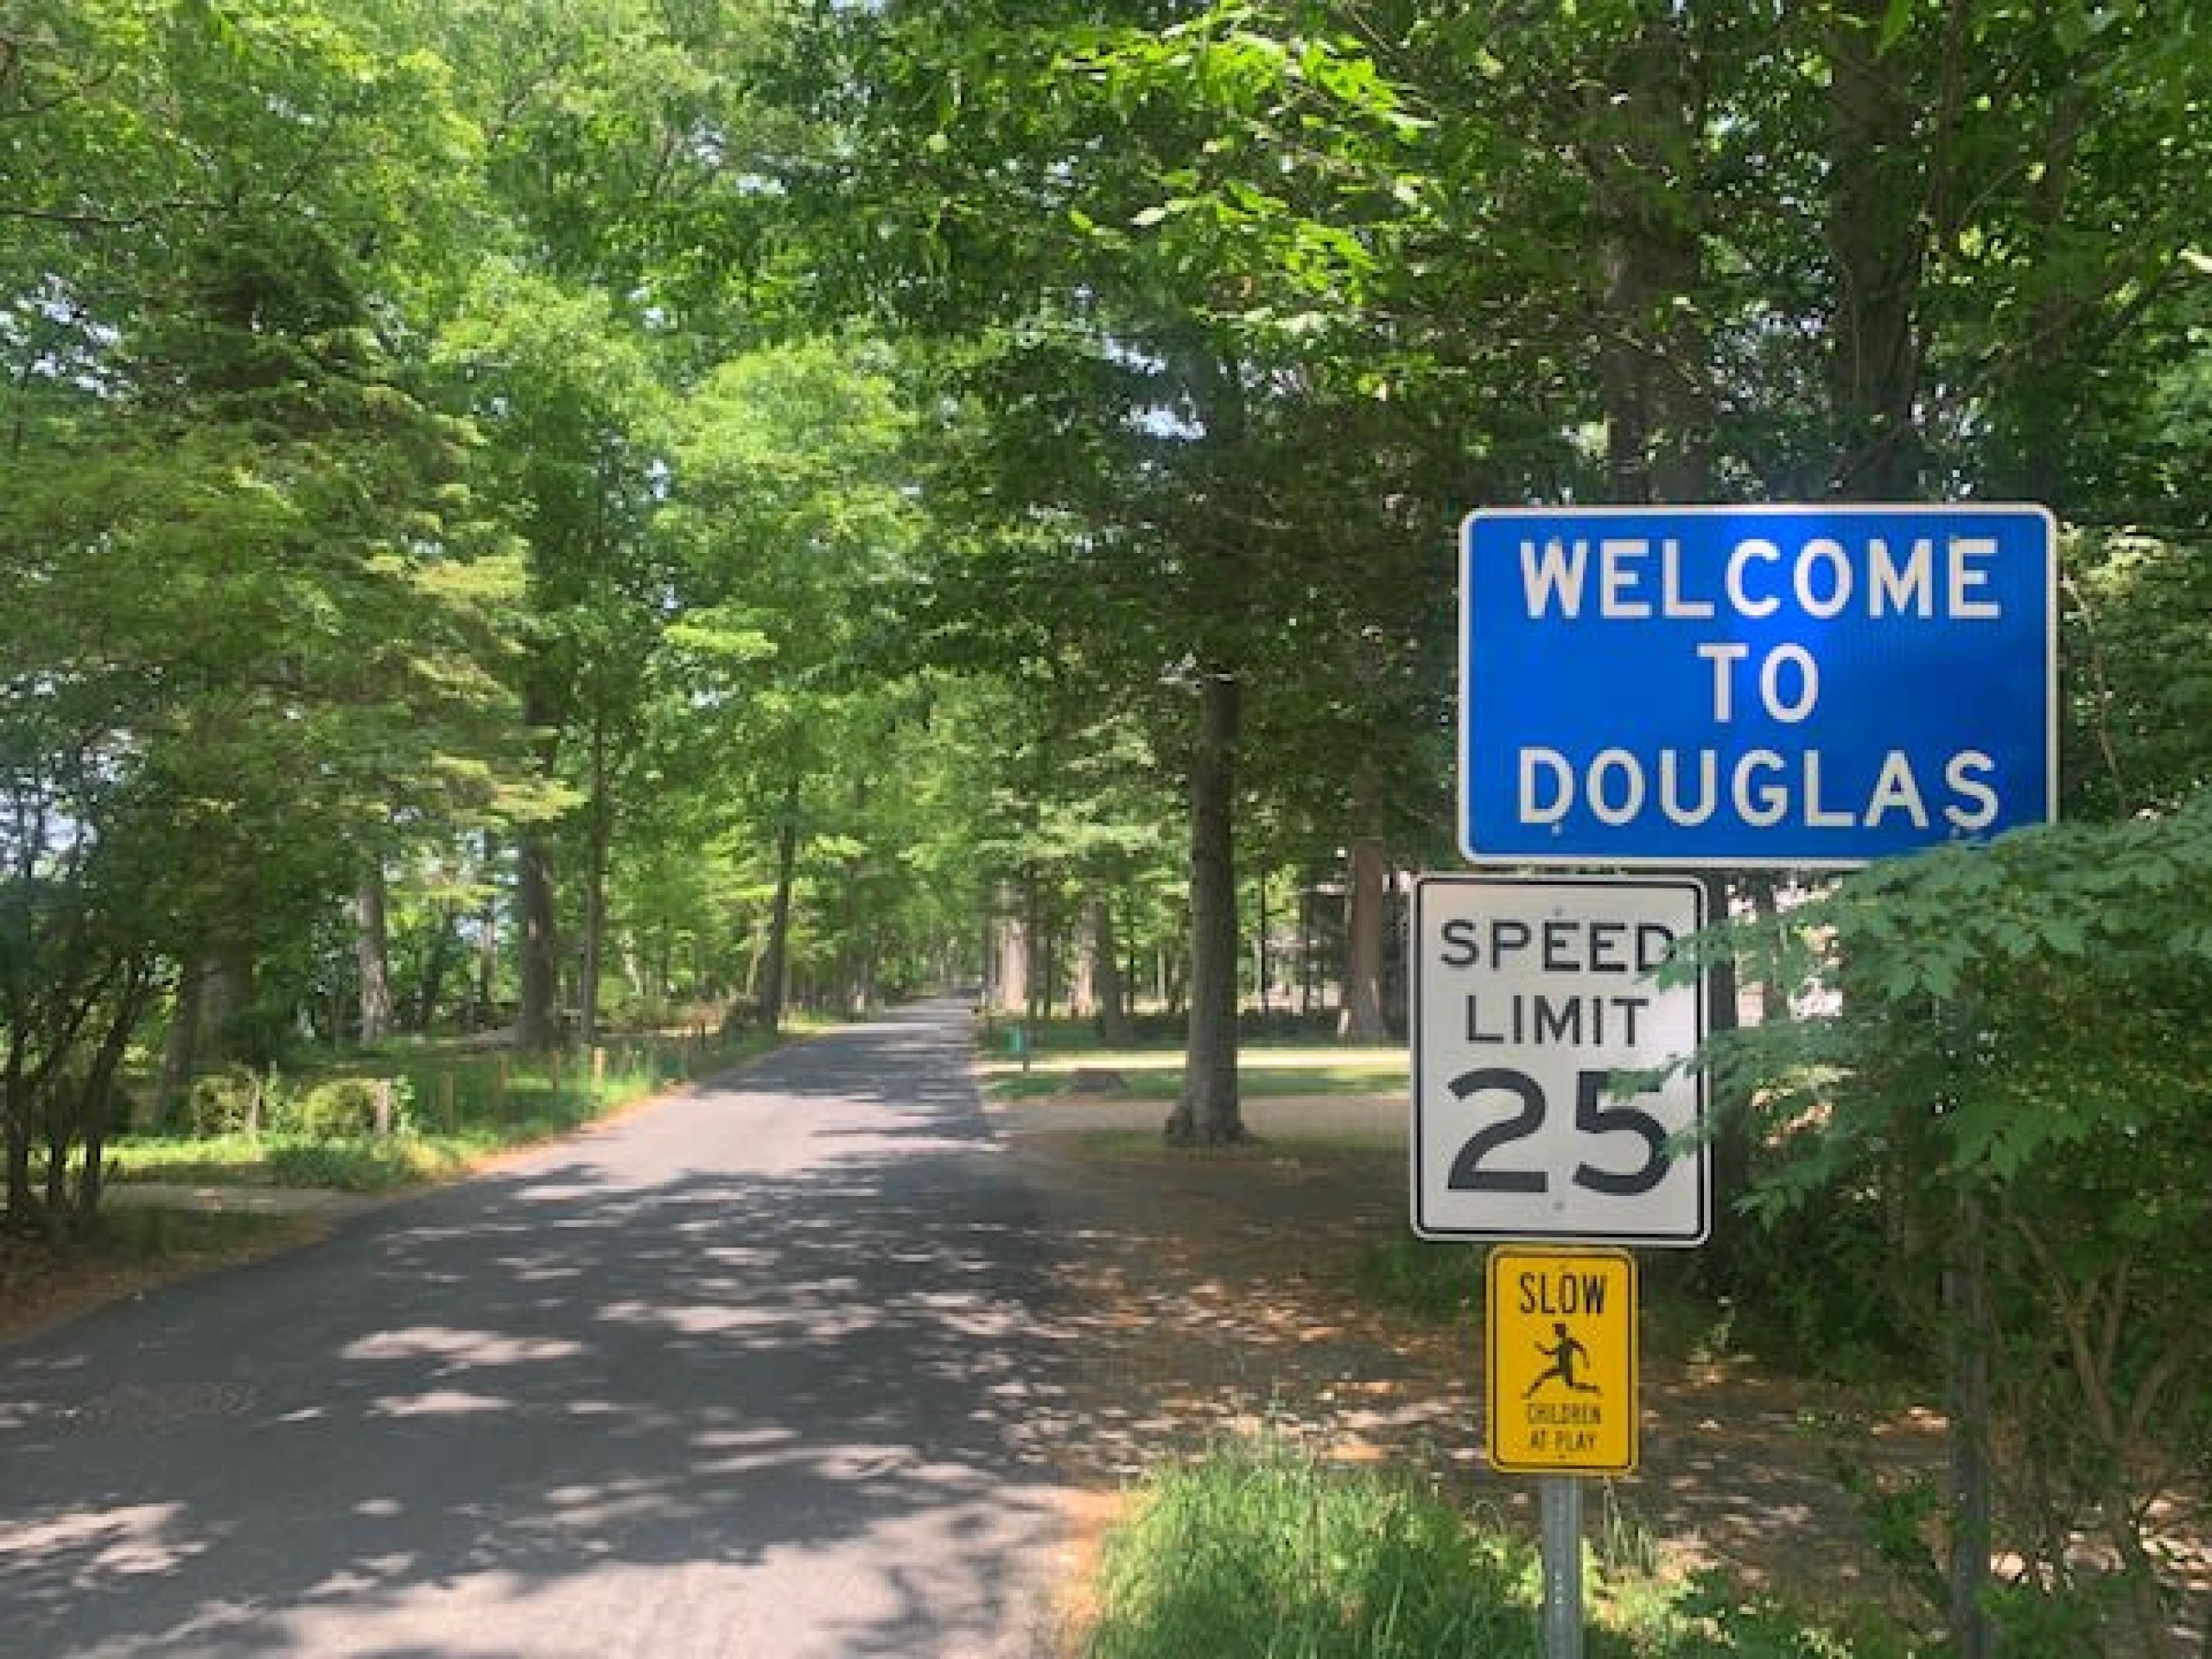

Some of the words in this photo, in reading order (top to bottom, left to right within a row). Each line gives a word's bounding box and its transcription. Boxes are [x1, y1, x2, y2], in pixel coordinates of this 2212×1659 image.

[1520, 539, 2001, 619] WELCOME
[1697, 642, 1820, 724] TO
[1519, 748, 2000, 829] DOUGLAS
[1441, 919, 1674, 973] SPEED
[1465, 995, 1650, 1046] LIMIT
[1447, 1068, 1672, 1196] 25
[1520, 1271, 1607, 1315] SLOW
[1526, 1402, 1601, 1425] CHILDREN
[1530, 1429, 1547, 1450] AT
[1554, 1430, 1597, 1452] PLAY
